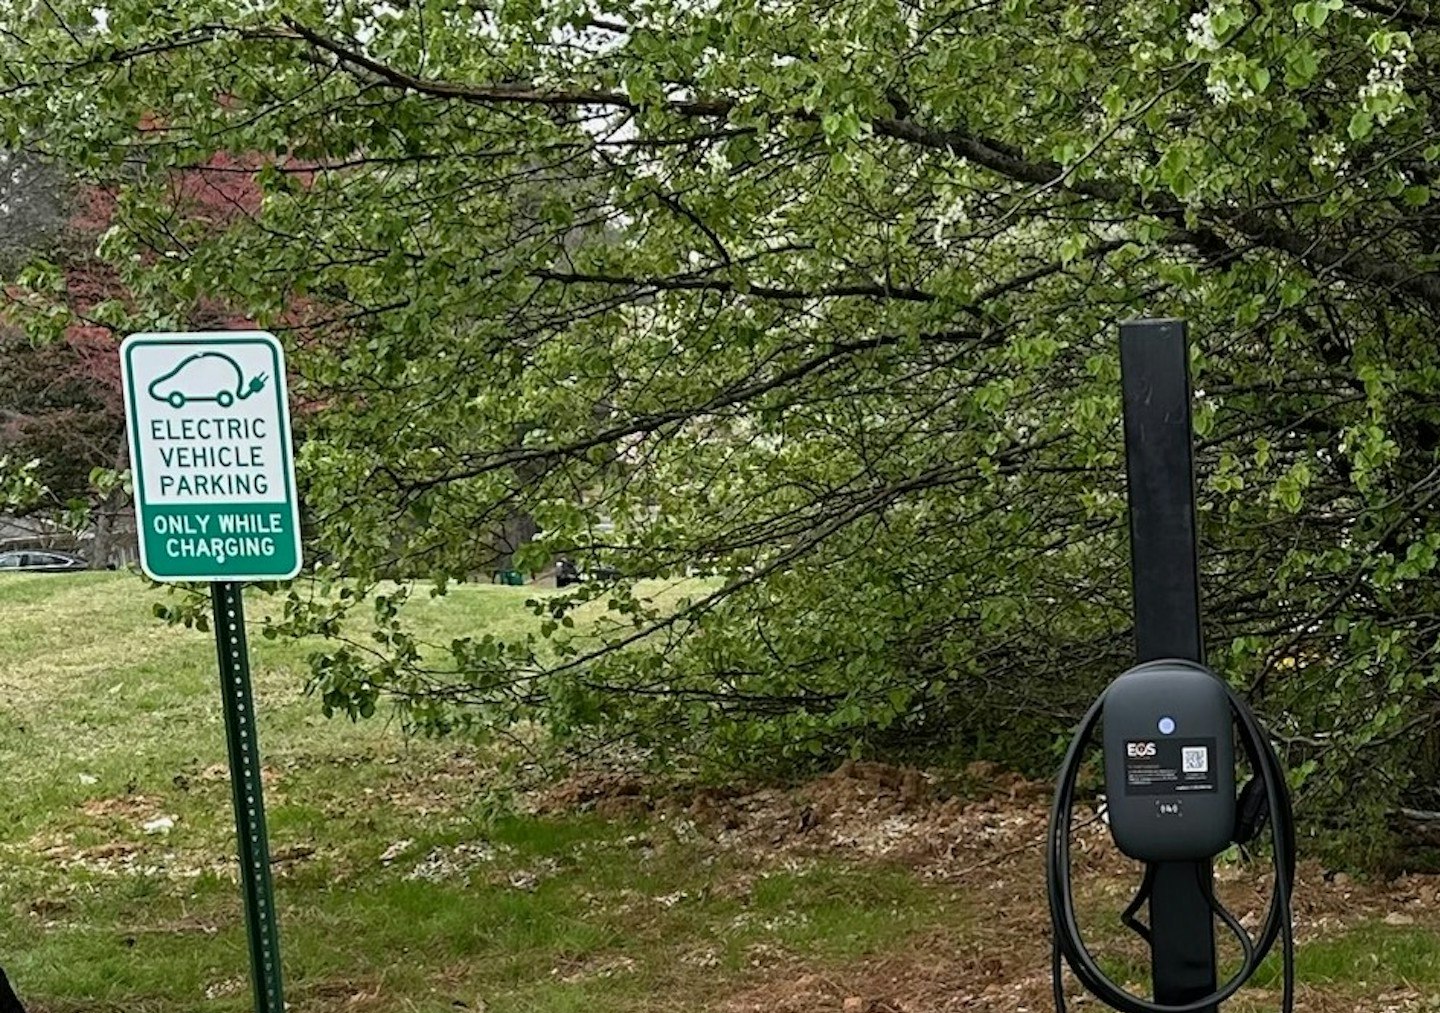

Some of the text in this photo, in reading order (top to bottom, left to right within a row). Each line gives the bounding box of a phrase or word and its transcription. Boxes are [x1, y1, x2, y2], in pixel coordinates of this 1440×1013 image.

[151, 418, 267, 440] ELECTRIC
[159, 446, 264, 467] VEHICLE
[160, 474, 268, 496] PARKING
[153, 513, 283, 535] ONLY WHILE
[166, 538, 275, 557] CHARGING
